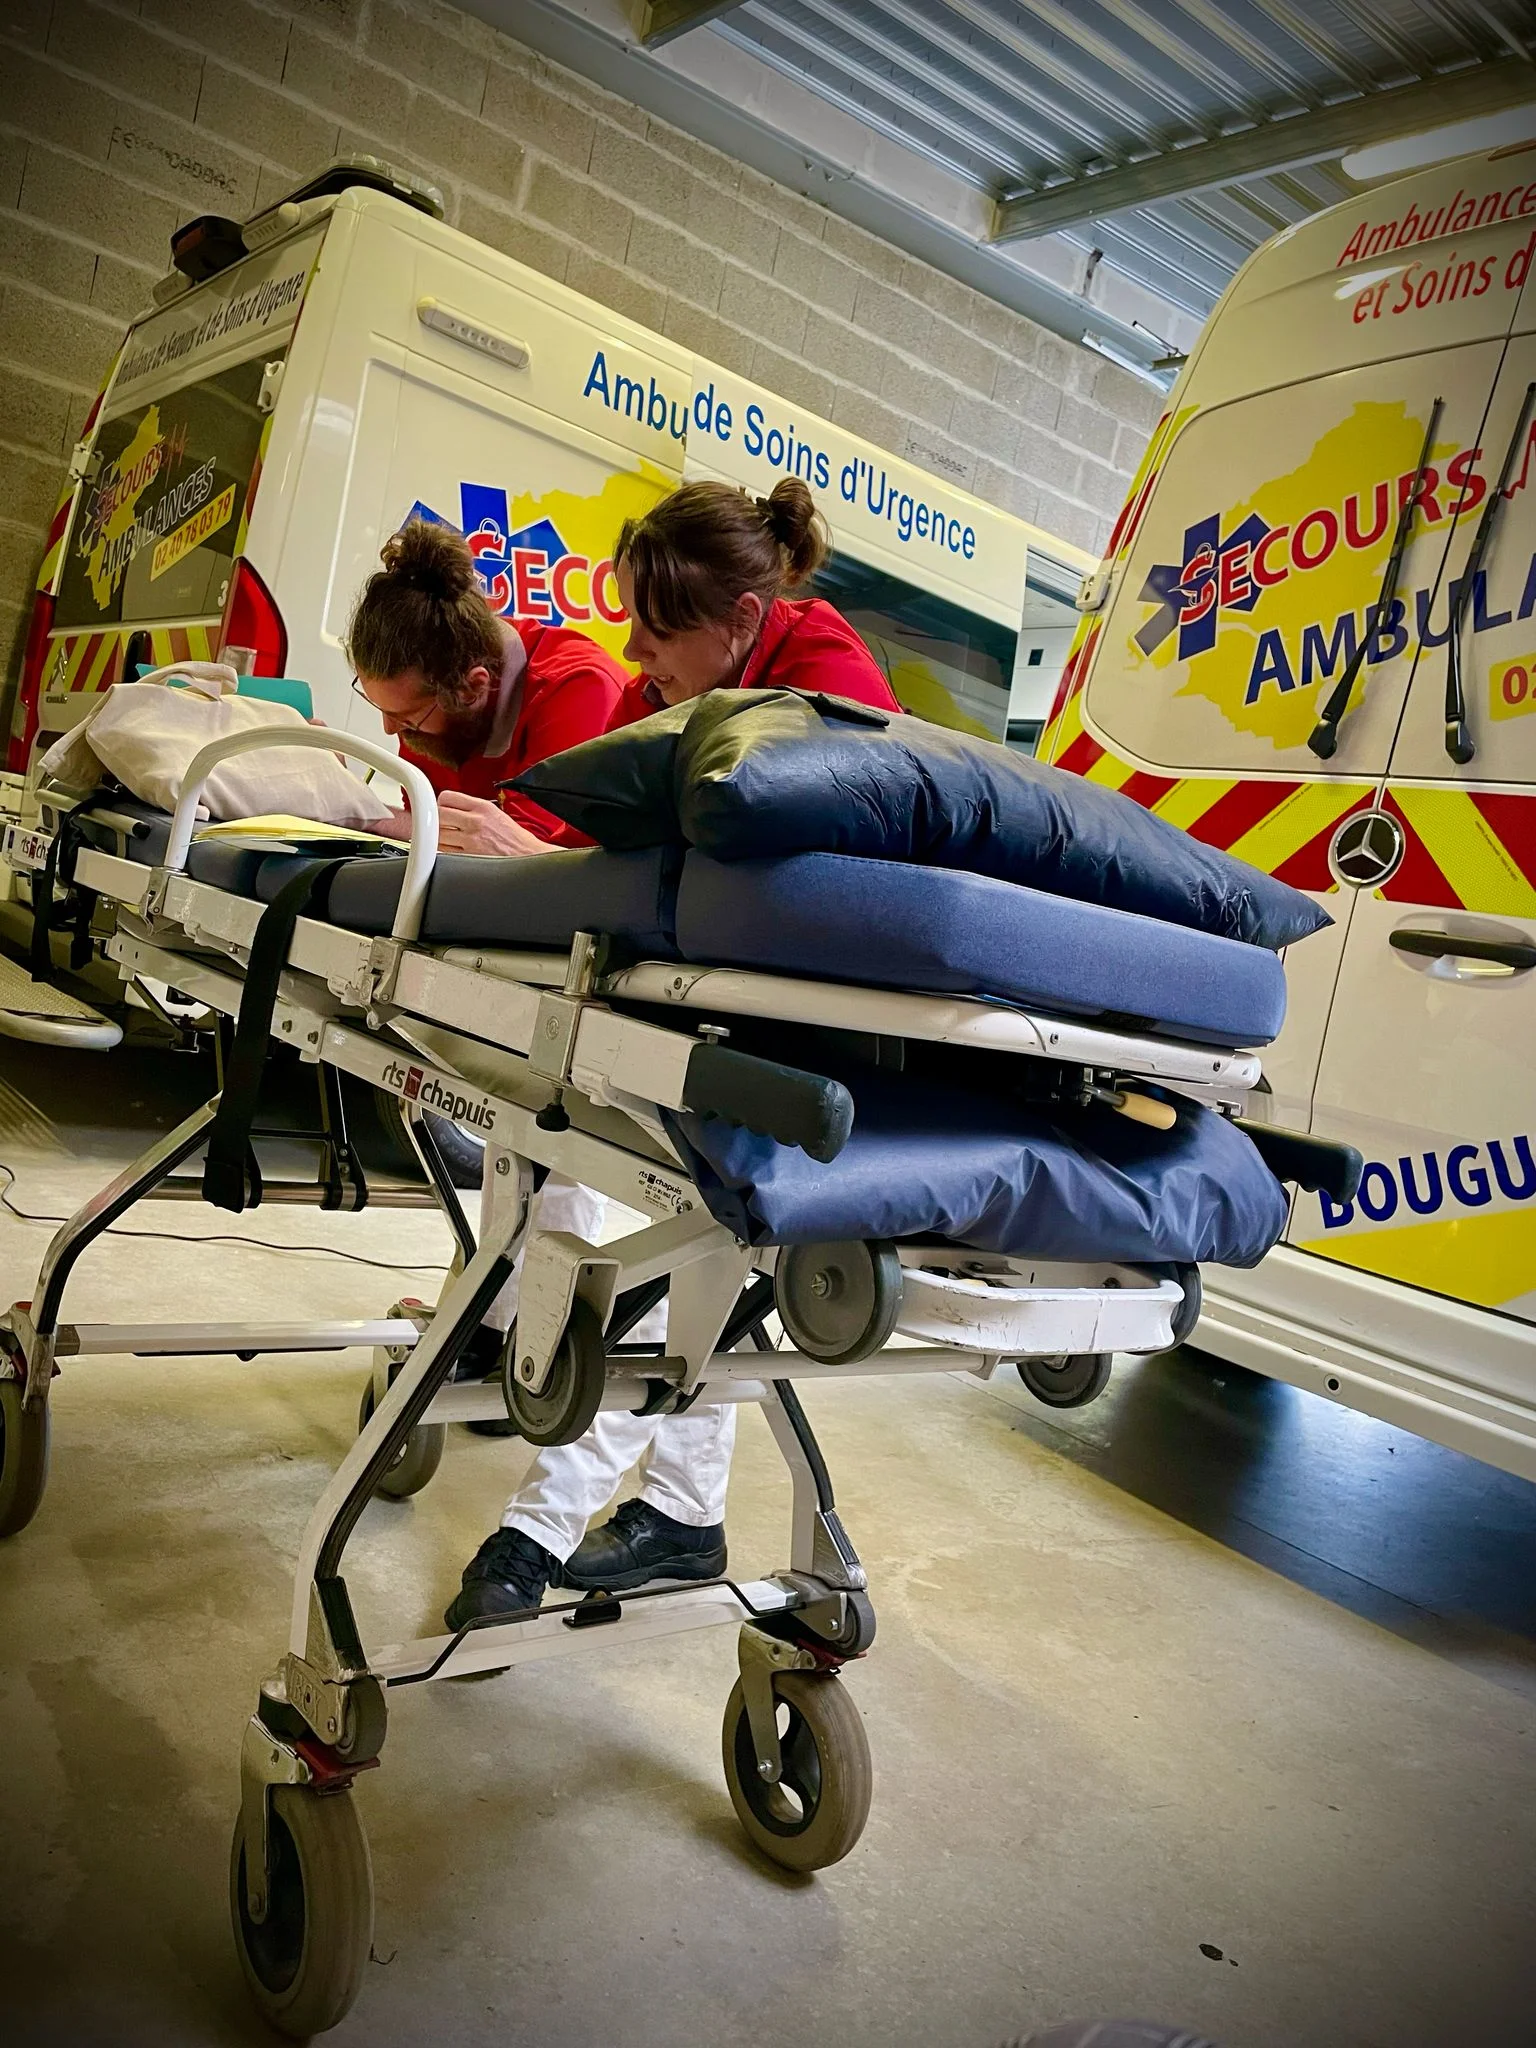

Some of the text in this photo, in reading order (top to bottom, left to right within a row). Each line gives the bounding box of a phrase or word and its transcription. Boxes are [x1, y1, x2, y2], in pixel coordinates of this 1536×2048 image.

[1336, 182, 1536, 267] Ambulance
[206, 303, 223, 342] de
[218, 290, 251, 336] Soins
[1353, 279, 1390, 324] et
[1392, 251, 1498, 314] Soins
[583, 351, 689, 440] Ambu
[694, 383, 733, 441] de
[744, 404, 830, 489] Soins
[841, 456, 976, 560] d'Urgence
[98, 456, 217, 583] AMBULANCES
[155, 543, 168, 571] 02
[184, 521, 198, 549] 78
[199, 506, 214, 536] 03
[215, 492, 232, 523] 79
[1179, 448, 1487, 624] SECOURS
[1503, 664, 1536, 704] 0
[382, 1061, 496, 1130] rts chapuis
[655, 1179, 682, 1195] chapuis
